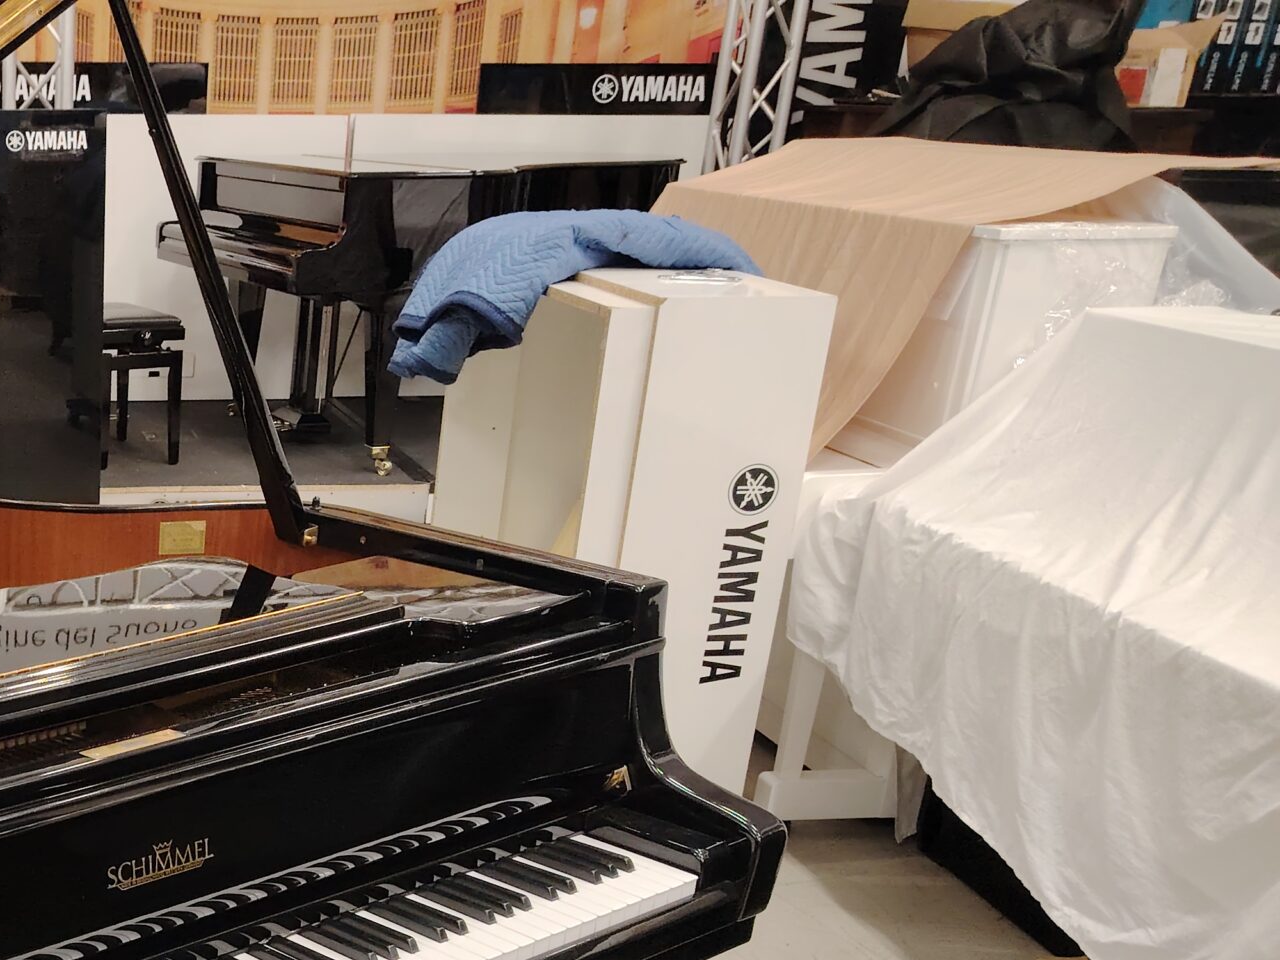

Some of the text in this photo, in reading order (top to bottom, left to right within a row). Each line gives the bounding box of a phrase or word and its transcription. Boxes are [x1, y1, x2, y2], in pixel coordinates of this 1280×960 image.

[621, 75, 705, 102] YAMAHA
[25, 130, 88, 151] YAMAHA
[699, 519, 769, 684] YAMAHA
[106, 838, 215, 889] SCHIMMEL
